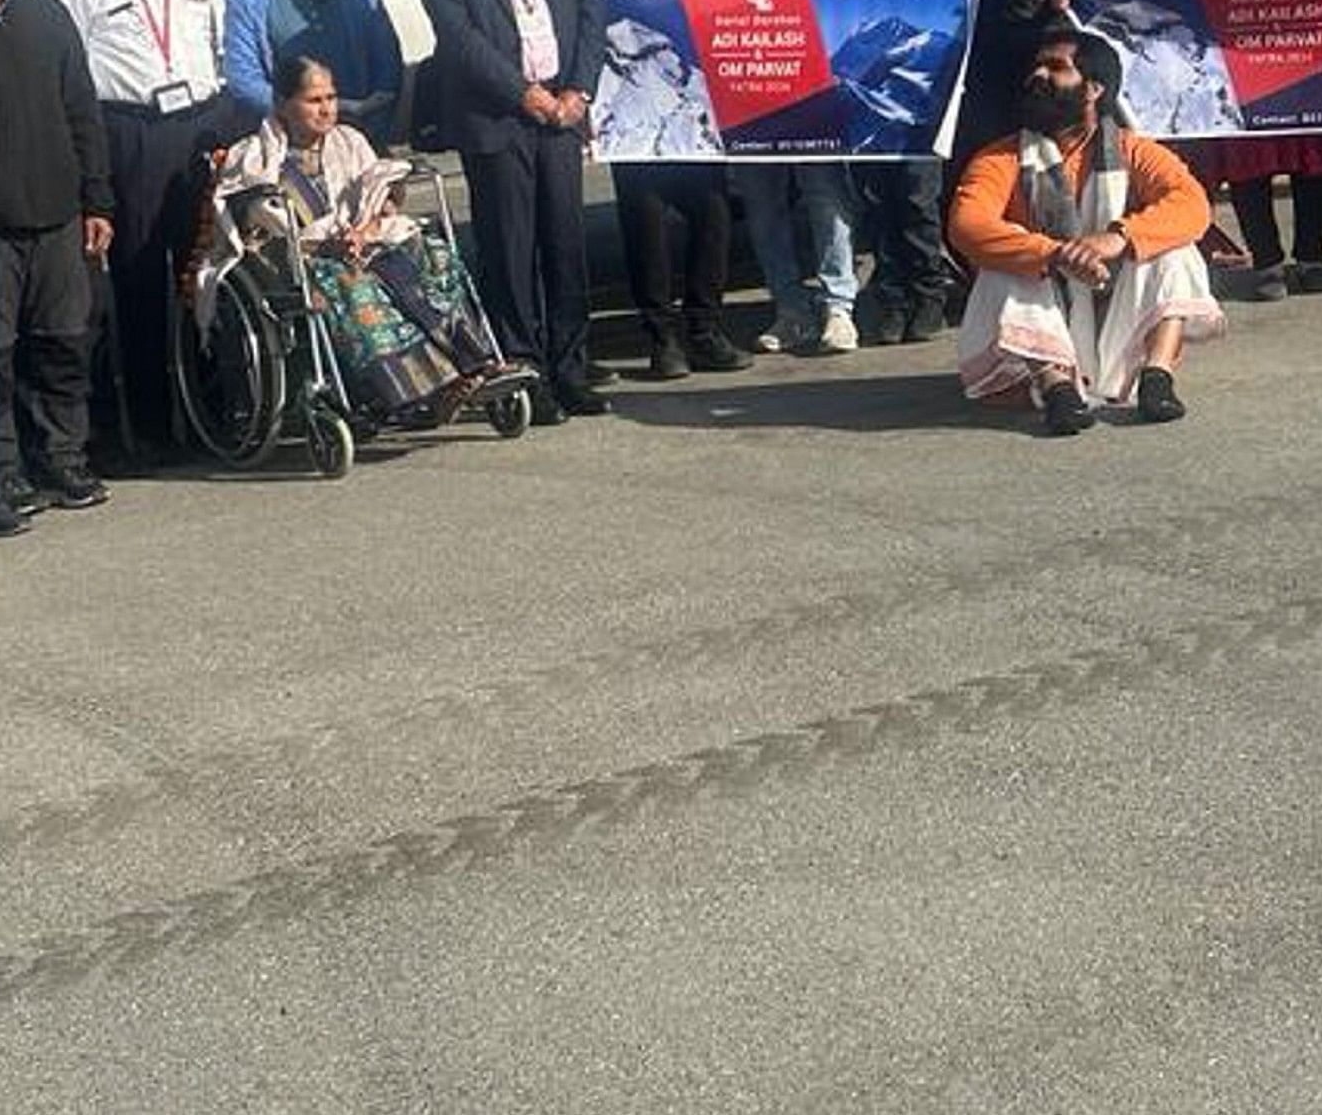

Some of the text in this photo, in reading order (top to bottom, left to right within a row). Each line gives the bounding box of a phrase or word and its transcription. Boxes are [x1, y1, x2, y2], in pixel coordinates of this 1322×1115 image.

[1227, 6, 1254, 23] ADI
[711, 30, 807, 49] ADI KAILASH
[1235, 31, 1322, 50] OM PARVAT
[718, 60, 800, 77] OM PARVAT
